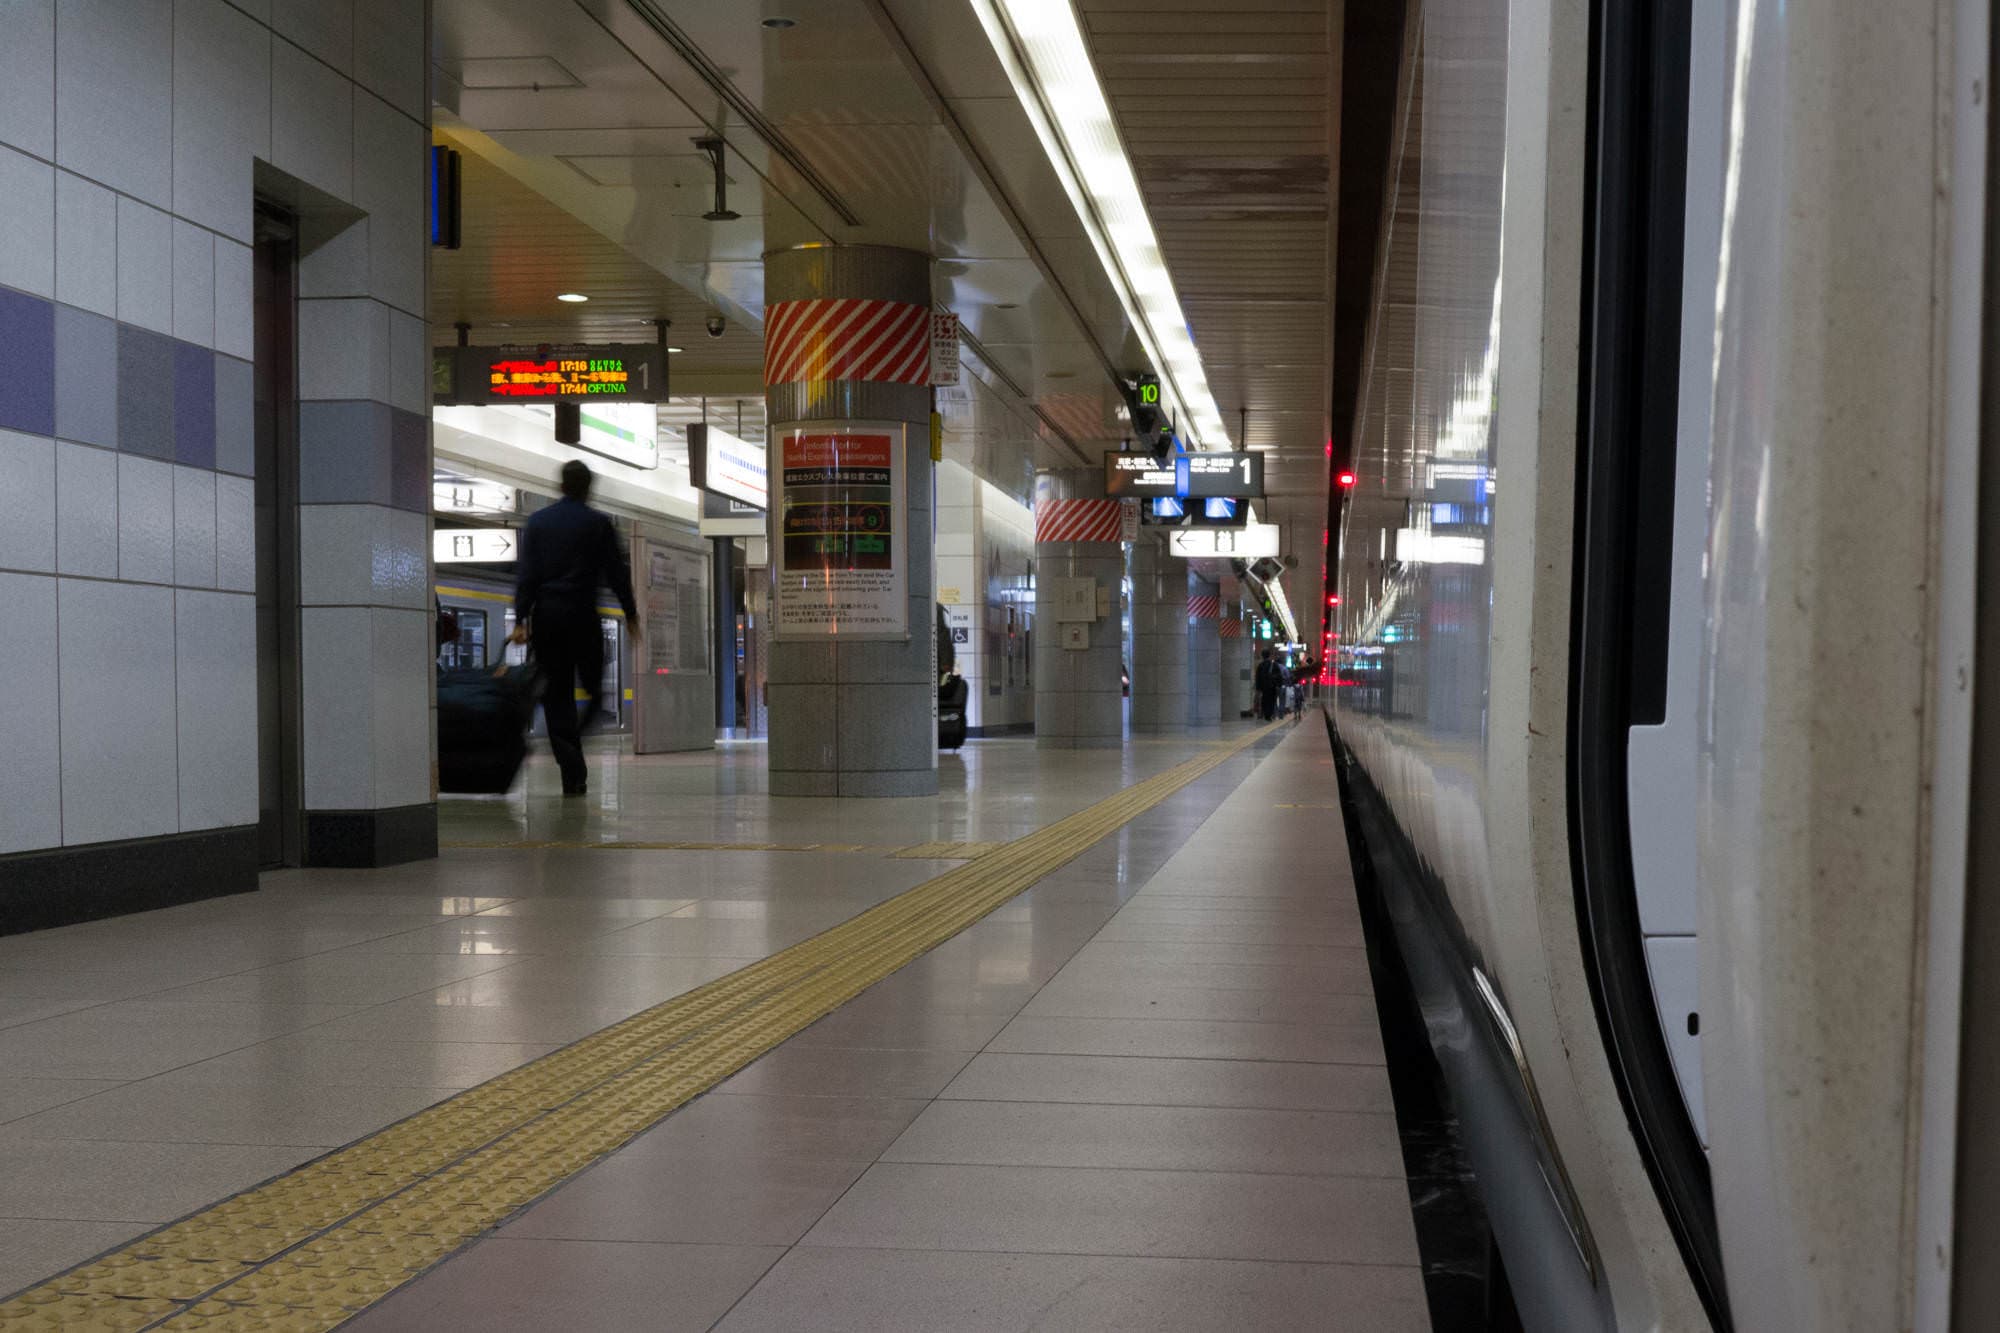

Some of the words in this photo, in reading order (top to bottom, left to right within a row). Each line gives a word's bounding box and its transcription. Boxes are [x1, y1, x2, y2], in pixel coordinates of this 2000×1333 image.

[560, 360, 587, 372] 17:16
[638, 362, 649, 390] 1
[560, 383, 587, 394] 17:44
[588, 383, 626, 393] OFUNA
[1140, 384, 1158, 403] 10
[1239, 458, 1251, 485] 1
